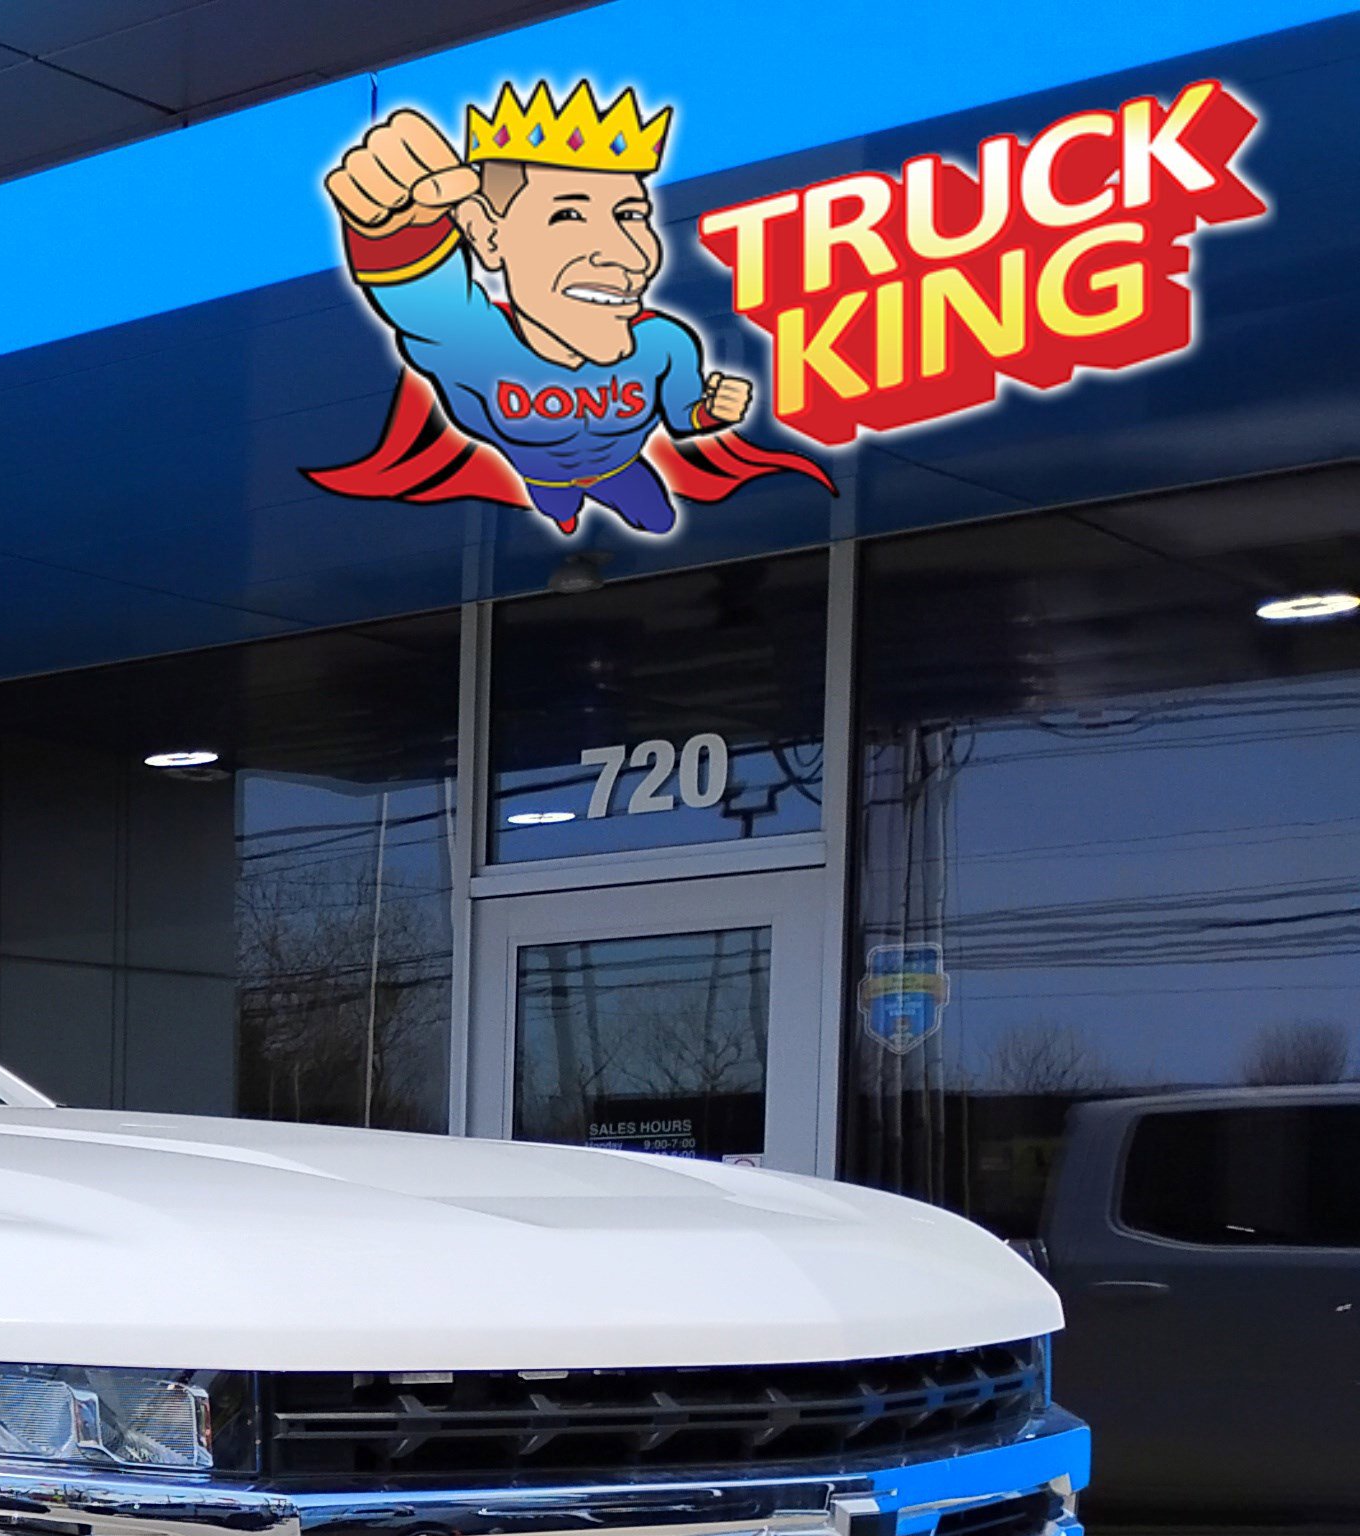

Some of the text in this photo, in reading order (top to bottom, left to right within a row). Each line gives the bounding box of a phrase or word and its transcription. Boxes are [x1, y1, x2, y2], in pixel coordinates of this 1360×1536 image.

[580, 734, 729, 820] 720
[589, 1119, 693, 1136] SALES HOURS
